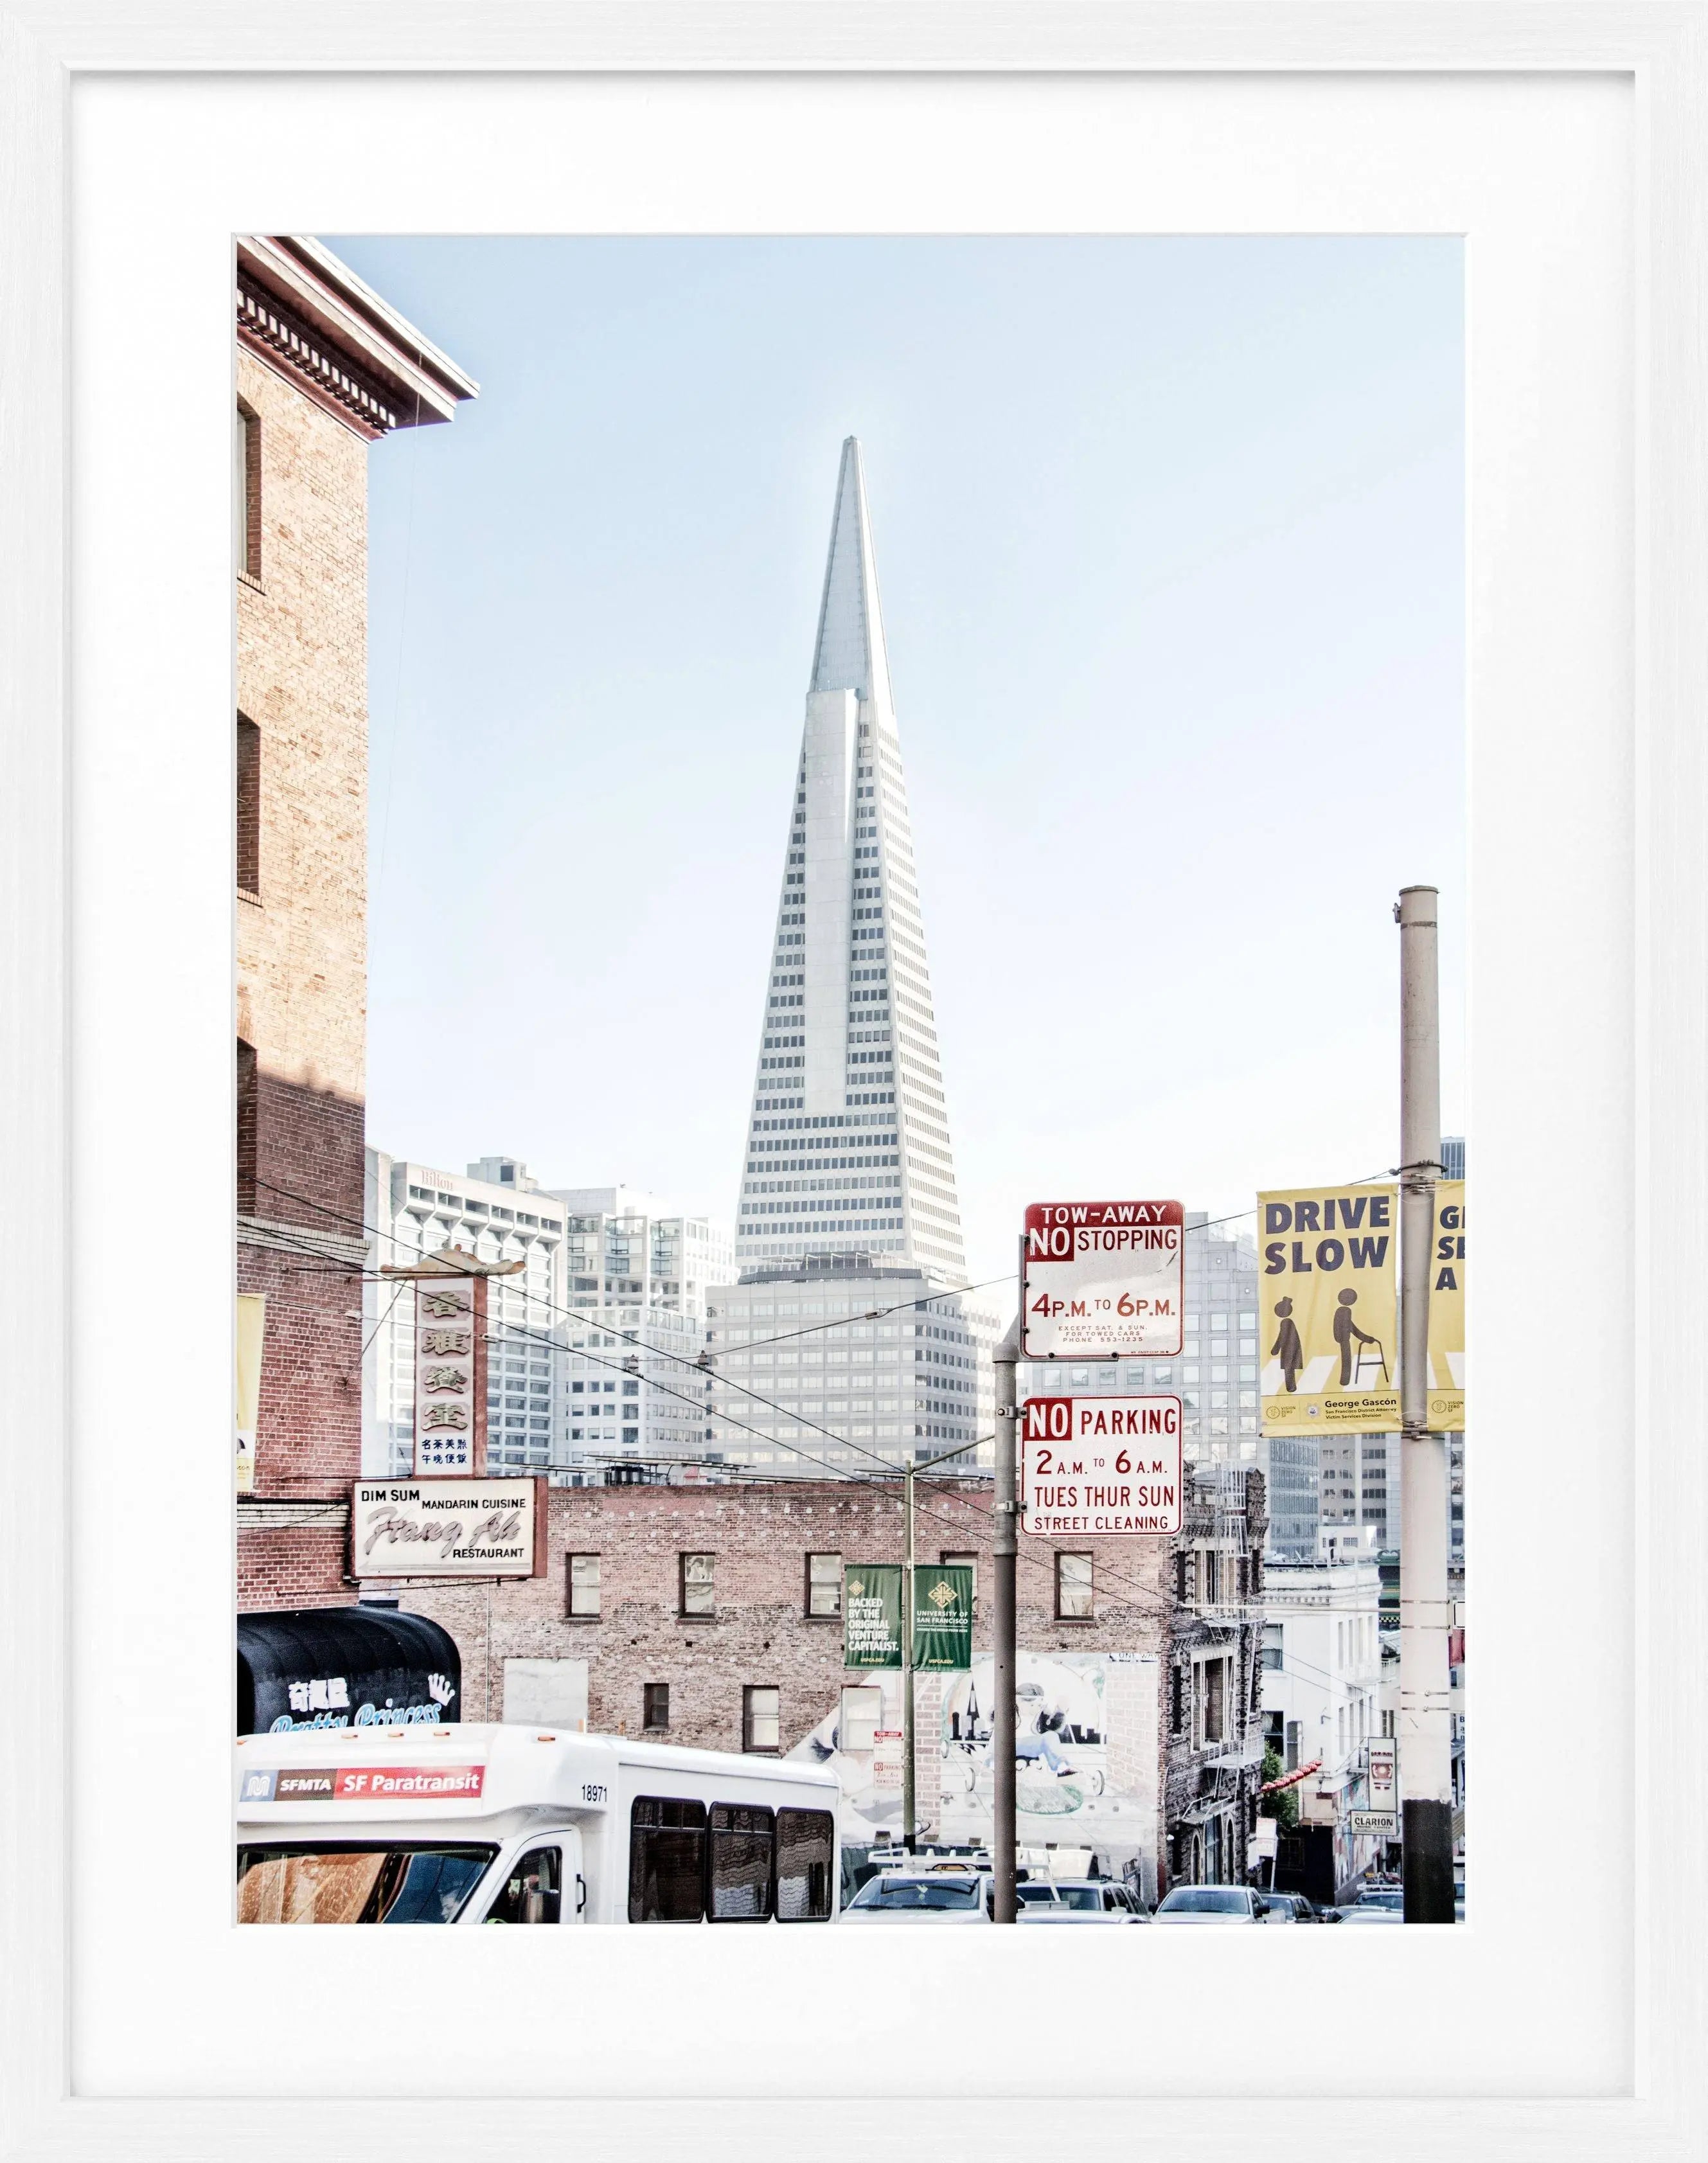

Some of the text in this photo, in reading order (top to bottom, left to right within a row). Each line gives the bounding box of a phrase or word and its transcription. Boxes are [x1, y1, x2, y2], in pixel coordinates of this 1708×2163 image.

[1042, 1205, 1167, 1224] TOW-AWAY
[1265, 1196, 1390, 1234] DRIVE
[1029, 1227, 1177, 1256] NO STOPPING
[1264, 1236, 1389, 1275] SLOW
[1435, 1267, 1457, 1290] A
[1094, 1299, 1111, 1311] TO
[1362, 1398, 1397, 1407] Gascón
[1029, 1403, 1177, 1438] NO PARKING
[1093, 1458, 1105, 1467] TO
[361, 1490, 420, 1502] DIM SUM
[1034, 1486, 1174, 1507] TUES THUR SUN
[422, 1499, 526, 1509] MANDARIN CUISINE
[1035, 1517, 1168, 1529] STREET CLEANING
[364, 1506, 521, 1559] Hang Ah
[453, 1548, 525, 1558] RESTAURANT
[848, 1598, 884, 1608] BACKED
[848, 1608, 880, 1619] BY THE
[848, 1619, 891, 1630] ORIGINAL
[848, 1630, 889, 1640] VENTURE
[848, 1641, 899, 1651] CAPITALIST.
[354, 1698, 442, 1727] Princess
[280, 1778, 332, 1791] SFMTA
[343, 1775, 368, 1792] SF
[372, 1773, 480, 1791] Paratransit
[582, 1785, 607, 1802] 18971
[1355, 1817, 1393, 1826] CLARION
